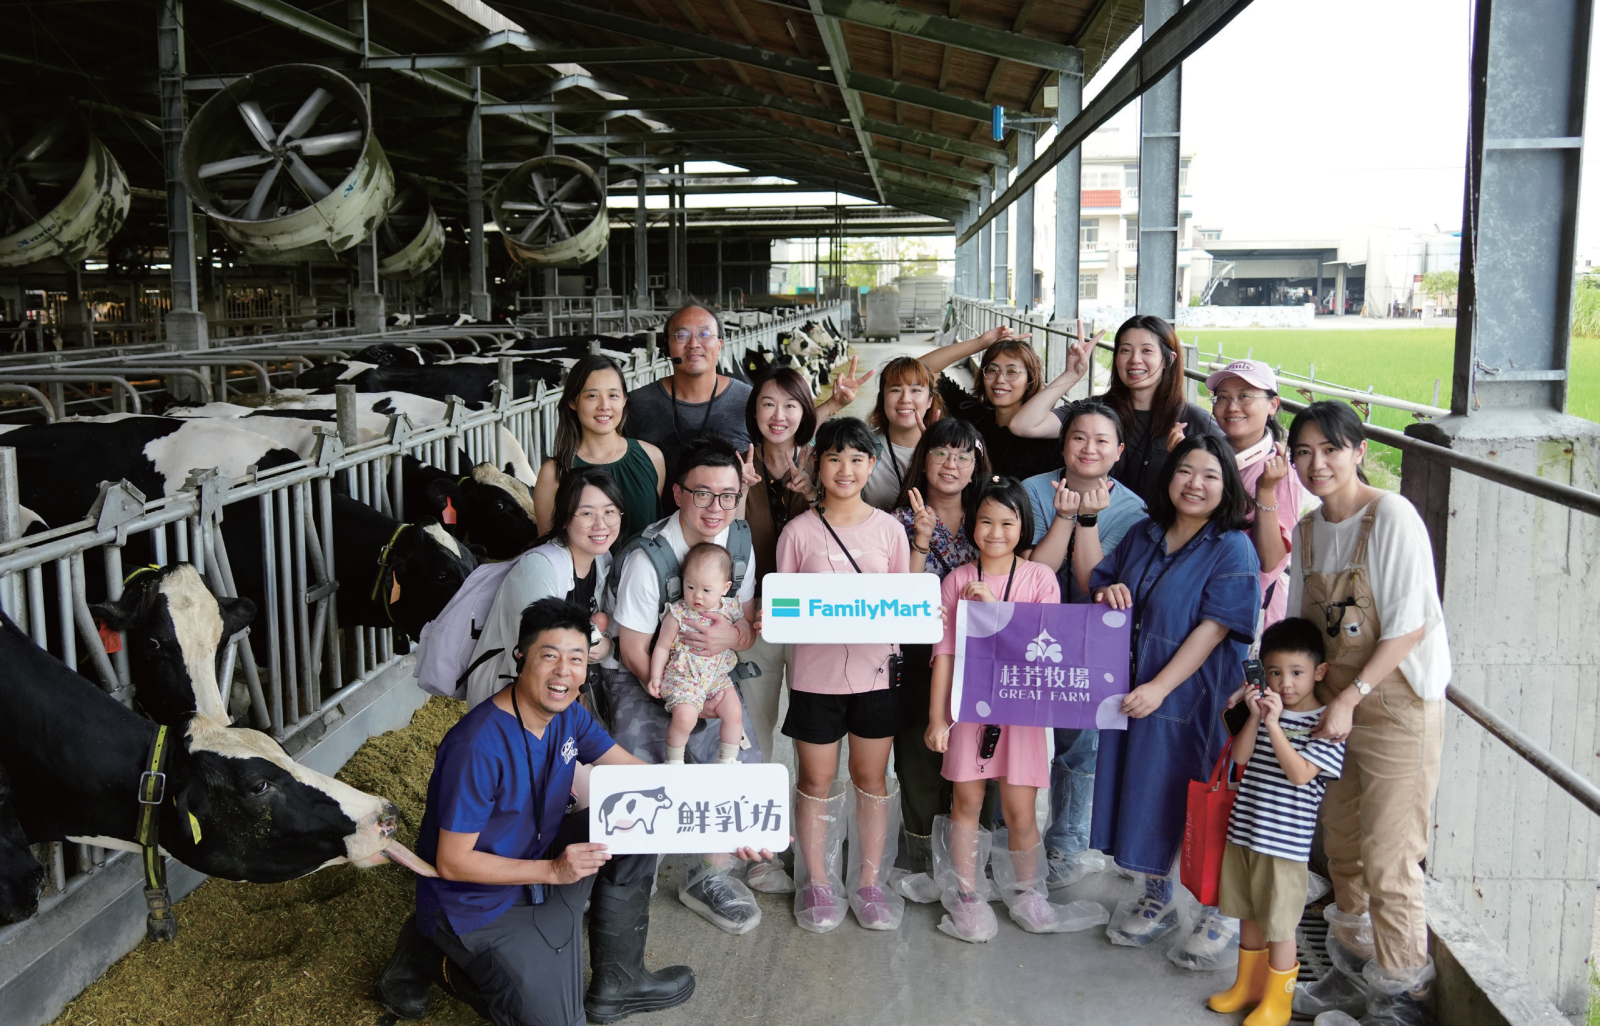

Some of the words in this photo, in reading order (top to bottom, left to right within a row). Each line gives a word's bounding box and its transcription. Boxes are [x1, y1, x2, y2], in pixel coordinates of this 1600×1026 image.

[808, 598, 932, 620] FamilyMart
[1000, 664, 1090, 689] 桂芳牧場
[998, 688, 1043, 701] GREAT
[1050, 691, 1090, 702] FARM
[676, 795, 782, 834] 鮮乳坊
